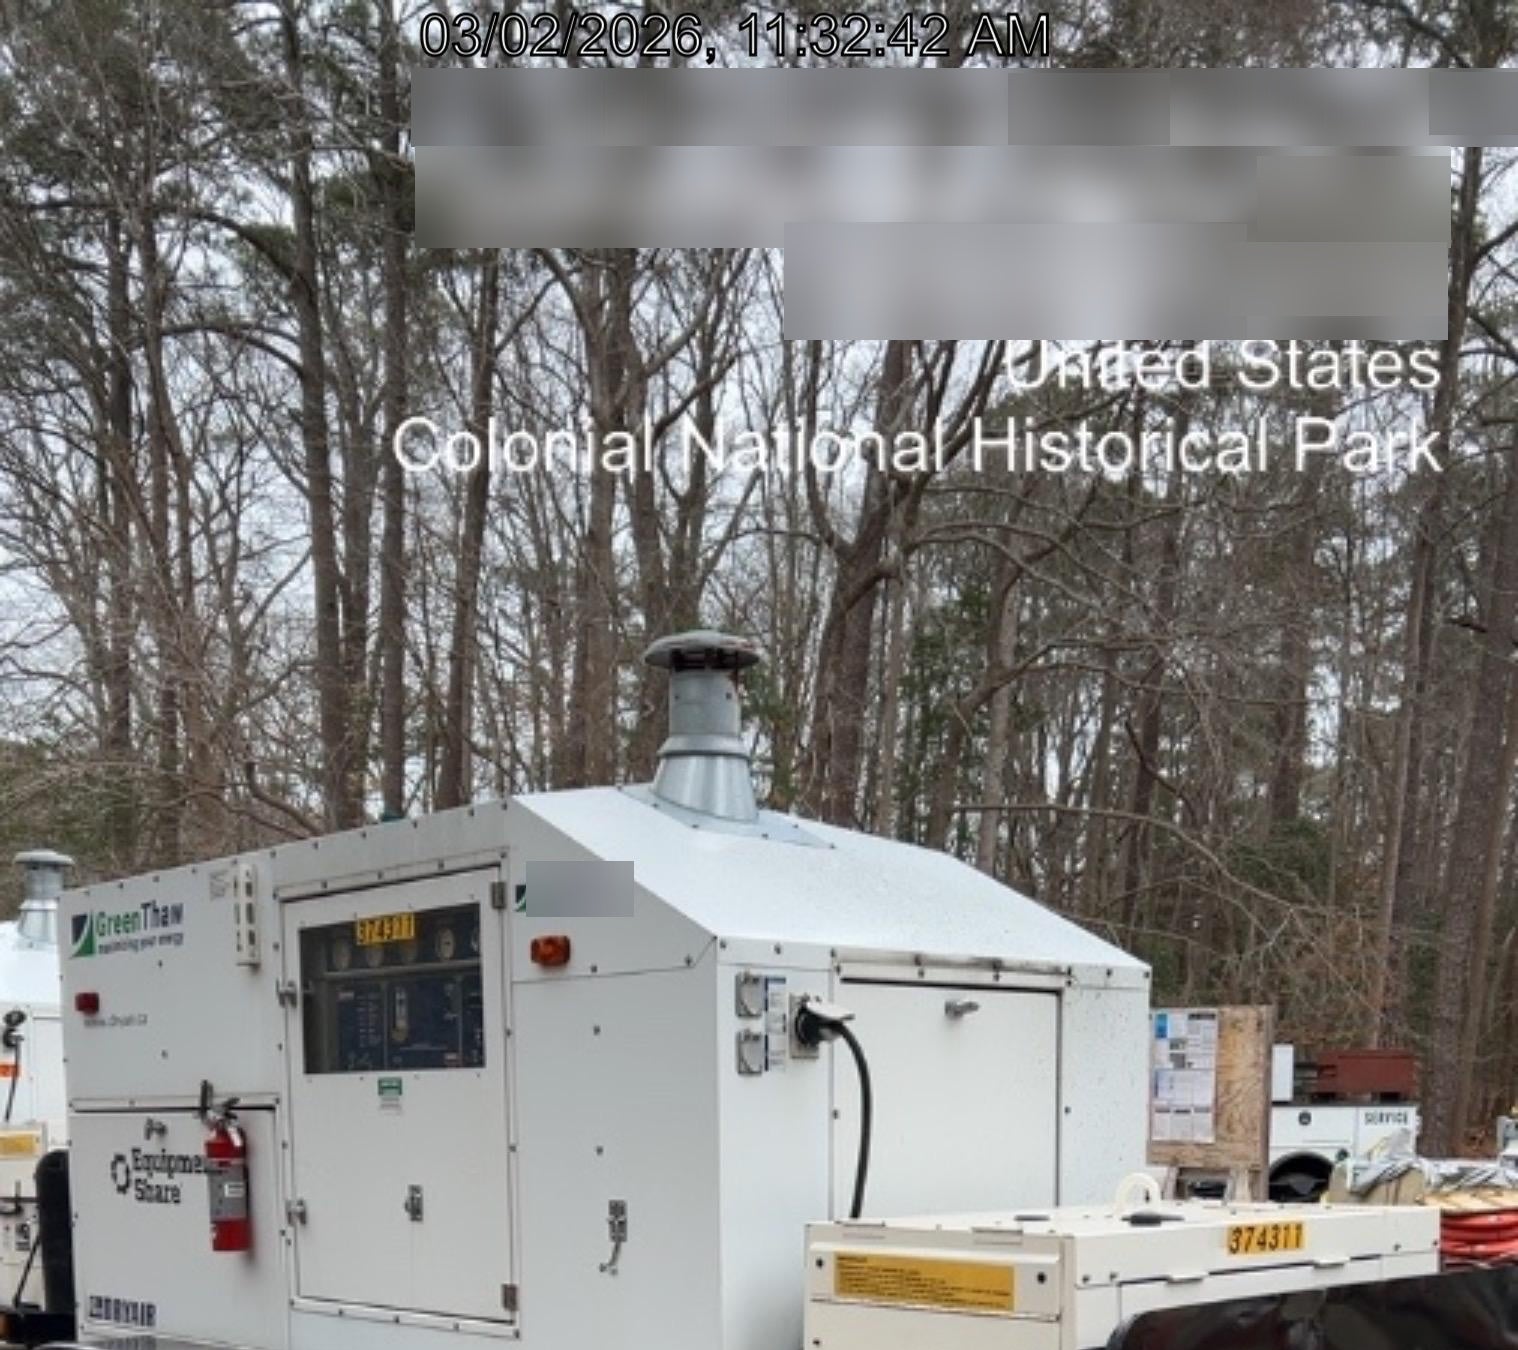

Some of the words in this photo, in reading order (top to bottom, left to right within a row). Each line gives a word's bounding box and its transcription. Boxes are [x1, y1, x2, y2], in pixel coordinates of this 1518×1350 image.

[132, 1148, 209, 1179] Equipme
[134, 1178, 182, 1204] Share
[1228, 1222, 1304, 1254] 374311
